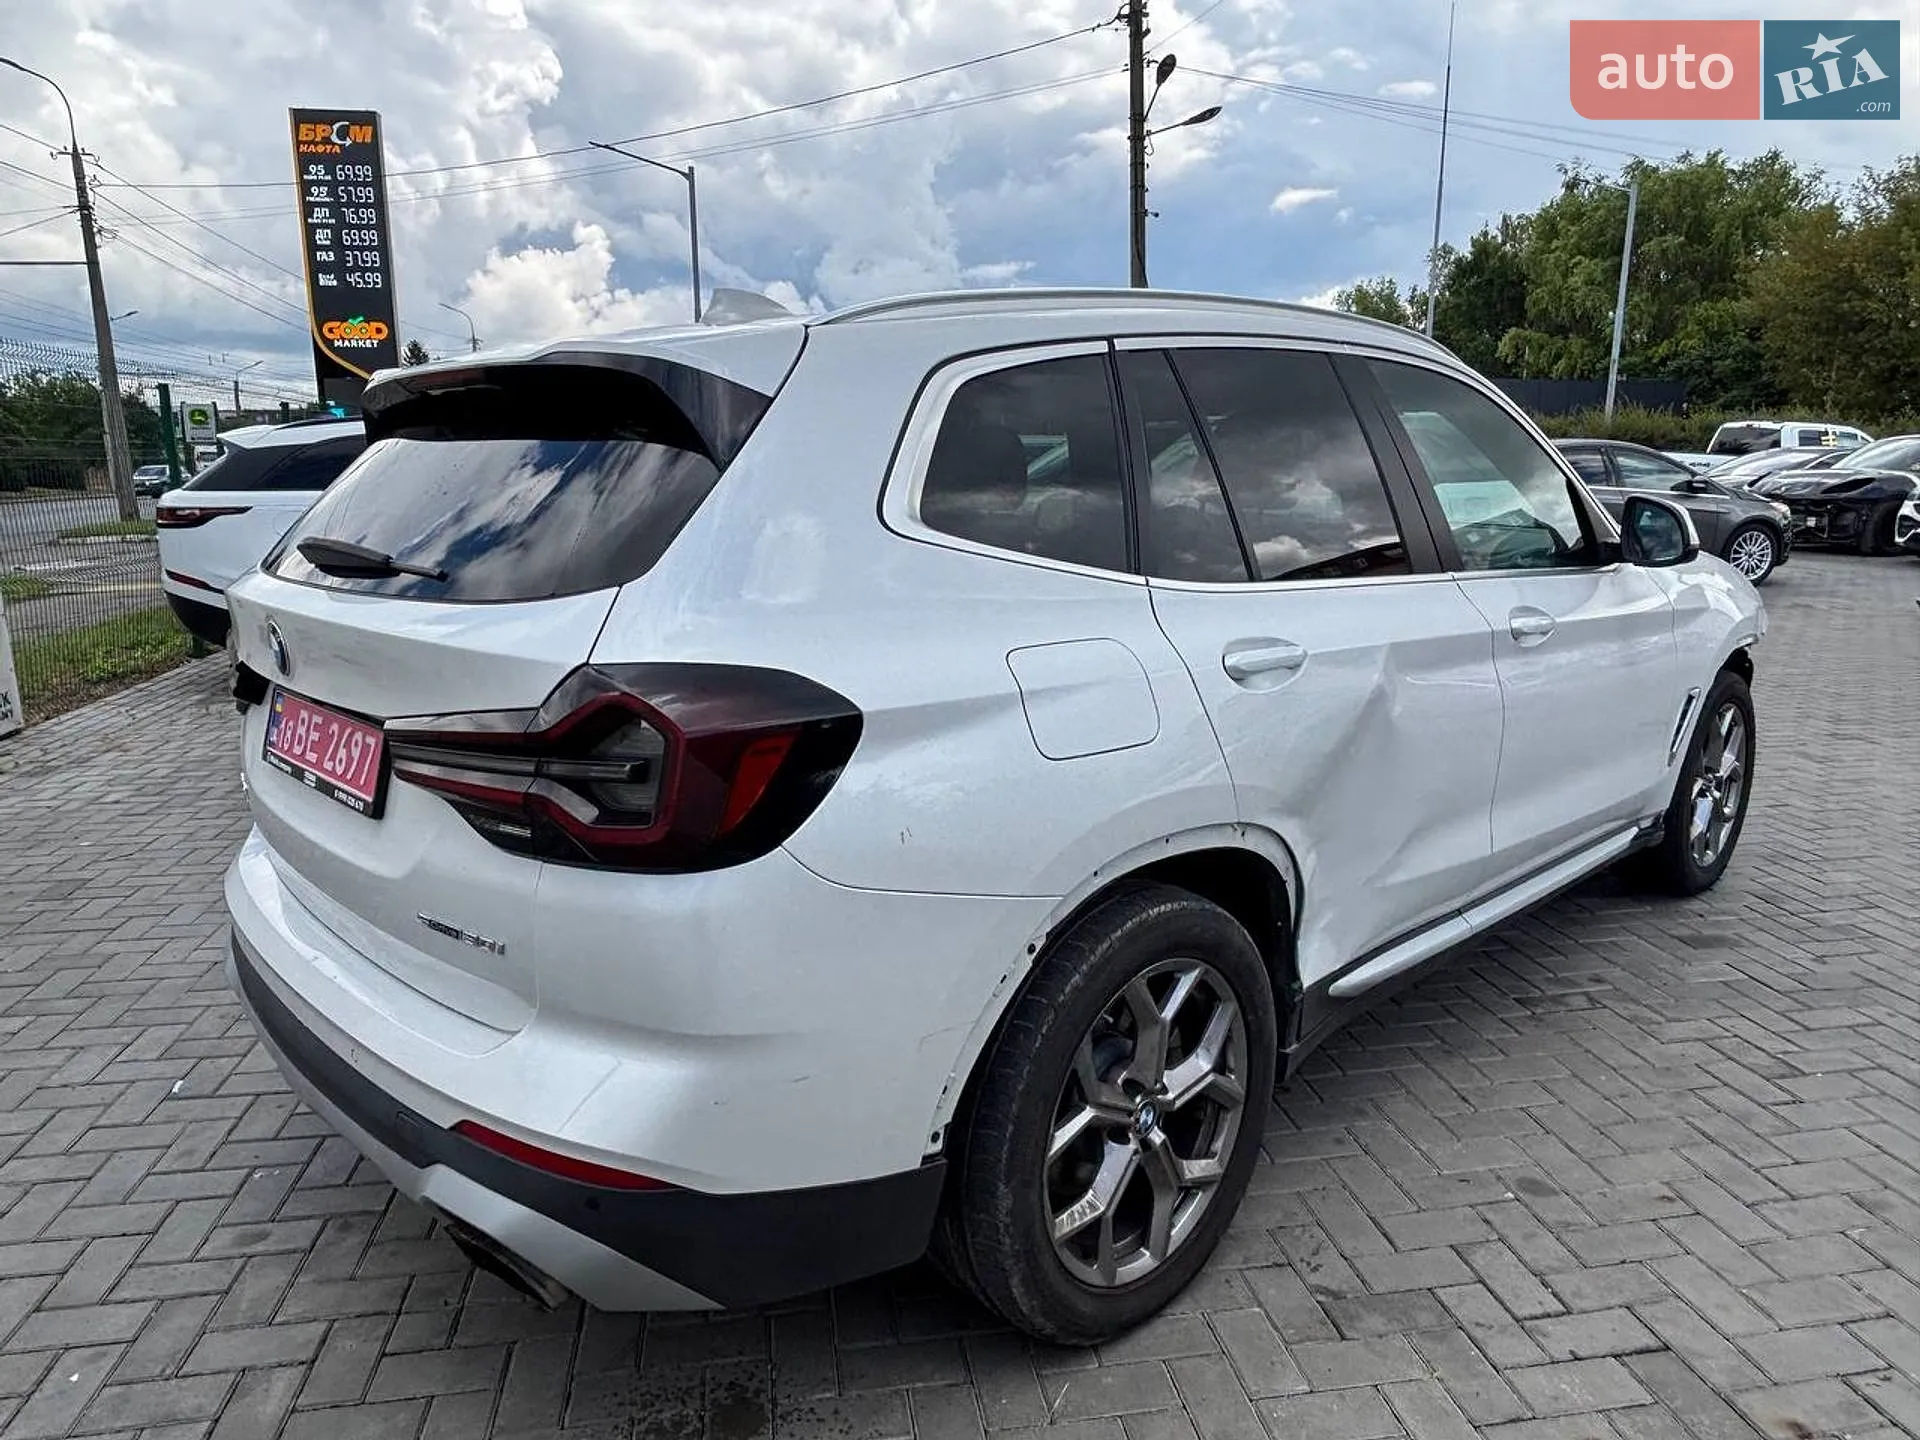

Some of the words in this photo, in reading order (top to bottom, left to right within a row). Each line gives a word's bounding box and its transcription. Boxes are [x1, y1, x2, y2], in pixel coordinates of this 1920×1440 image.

[299, 144, 341, 154] НАФТА
[309, 165, 325, 175] 95
[336, 165, 373, 181] 69.99
[338, 186, 375, 203] 57.99
[313, 208, 330, 219] ДП
[341, 208, 377, 224] 76.99
[342, 229, 378, 246] 69.99
[316, 251, 335, 261] ГАЗ
[345, 251, 380, 267] 37.99
[346, 272, 382, 288] 45.99
[322, 321, 389, 340] GOOD
[334, 339, 379, 348] MARKET
[293, 709, 323, 764] BE
[322, 722, 376, 786] 2697
